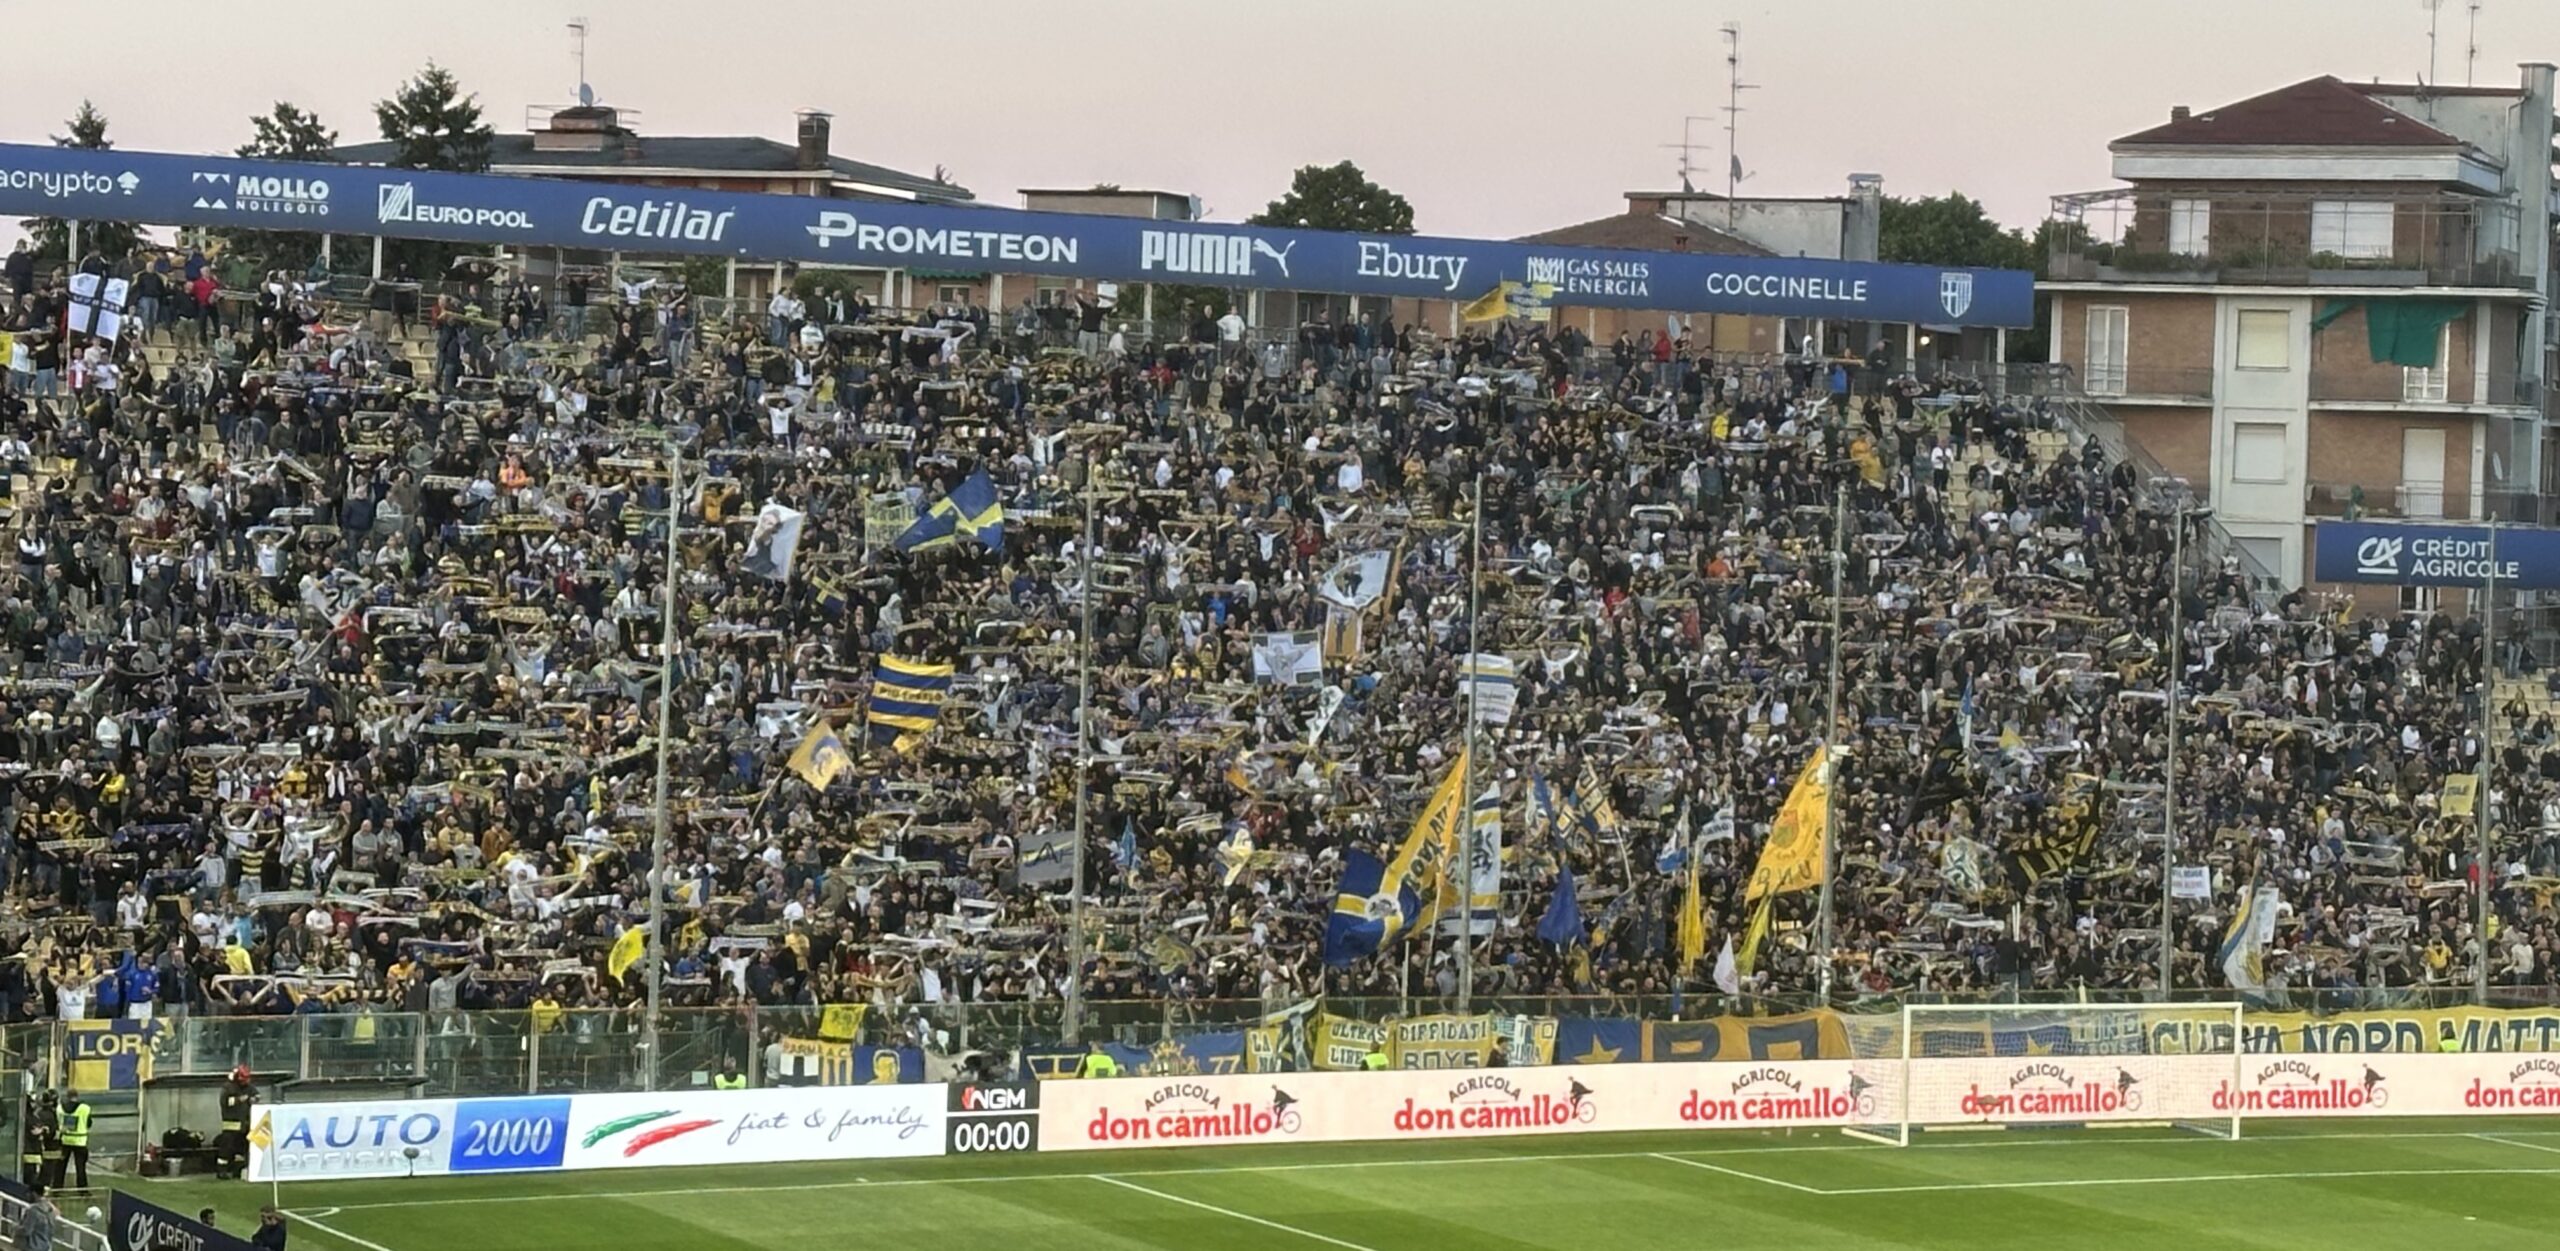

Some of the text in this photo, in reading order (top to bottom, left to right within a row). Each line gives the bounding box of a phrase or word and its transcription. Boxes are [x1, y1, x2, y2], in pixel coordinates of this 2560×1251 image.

[0, 170, 112, 197] acrypto
[236, 175, 329, 199] MOLLO
[236, 200, 329, 215] NOLEGGIO
[581, 197, 734, 241] Cetilar
[806, 211, 1078, 263] PROMETEON
[1141, 230, 1251, 275] PUMA
[1358, 241, 1468, 291] Ebury
[1567, 258, 1649, 278] GAS SALES
[1568, 276, 1649, 296] ENERGIA
[1706, 272, 1867, 301] COCCINELLE
[2411, 536, 2490, 557] CRÉDIT
[2411, 560, 2519, 579] AGRICOLE
[1330, 1023, 1388, 1044] ULTRAS
[1399, 1021, 1487, 1042] DIFFIDATI
[1731, 1068, 1802, 1094] AGRICOLA
[2009, 1063, 2075, 1088] AGRICOLA
[2257, 1060, 2320, 1085] AGRICOLA
[968, 1087, 1027, 1109] NGM
[1144, 1083, 1221, 1112] AGRICOLA
[1449, 1076, 1522, 1102] AGRICOLA
[1962, 1083, 2117, 1115] don camillo
[2212, 1080, 2363, 1110] don camillo
[2465, 1078, 2515, 1107] don
[1394, 1094, 1568, 1131] don camillo
[1680, 1087, 1848, 1121] don camillo
[280, 1113, 553, 1157] AUTO 2000
[727, 1106, 929, 1145] fiat & family
[954, 1119, 1030, 1153] 00:00
[1088, 1103, 1272, 1141] don camillo
